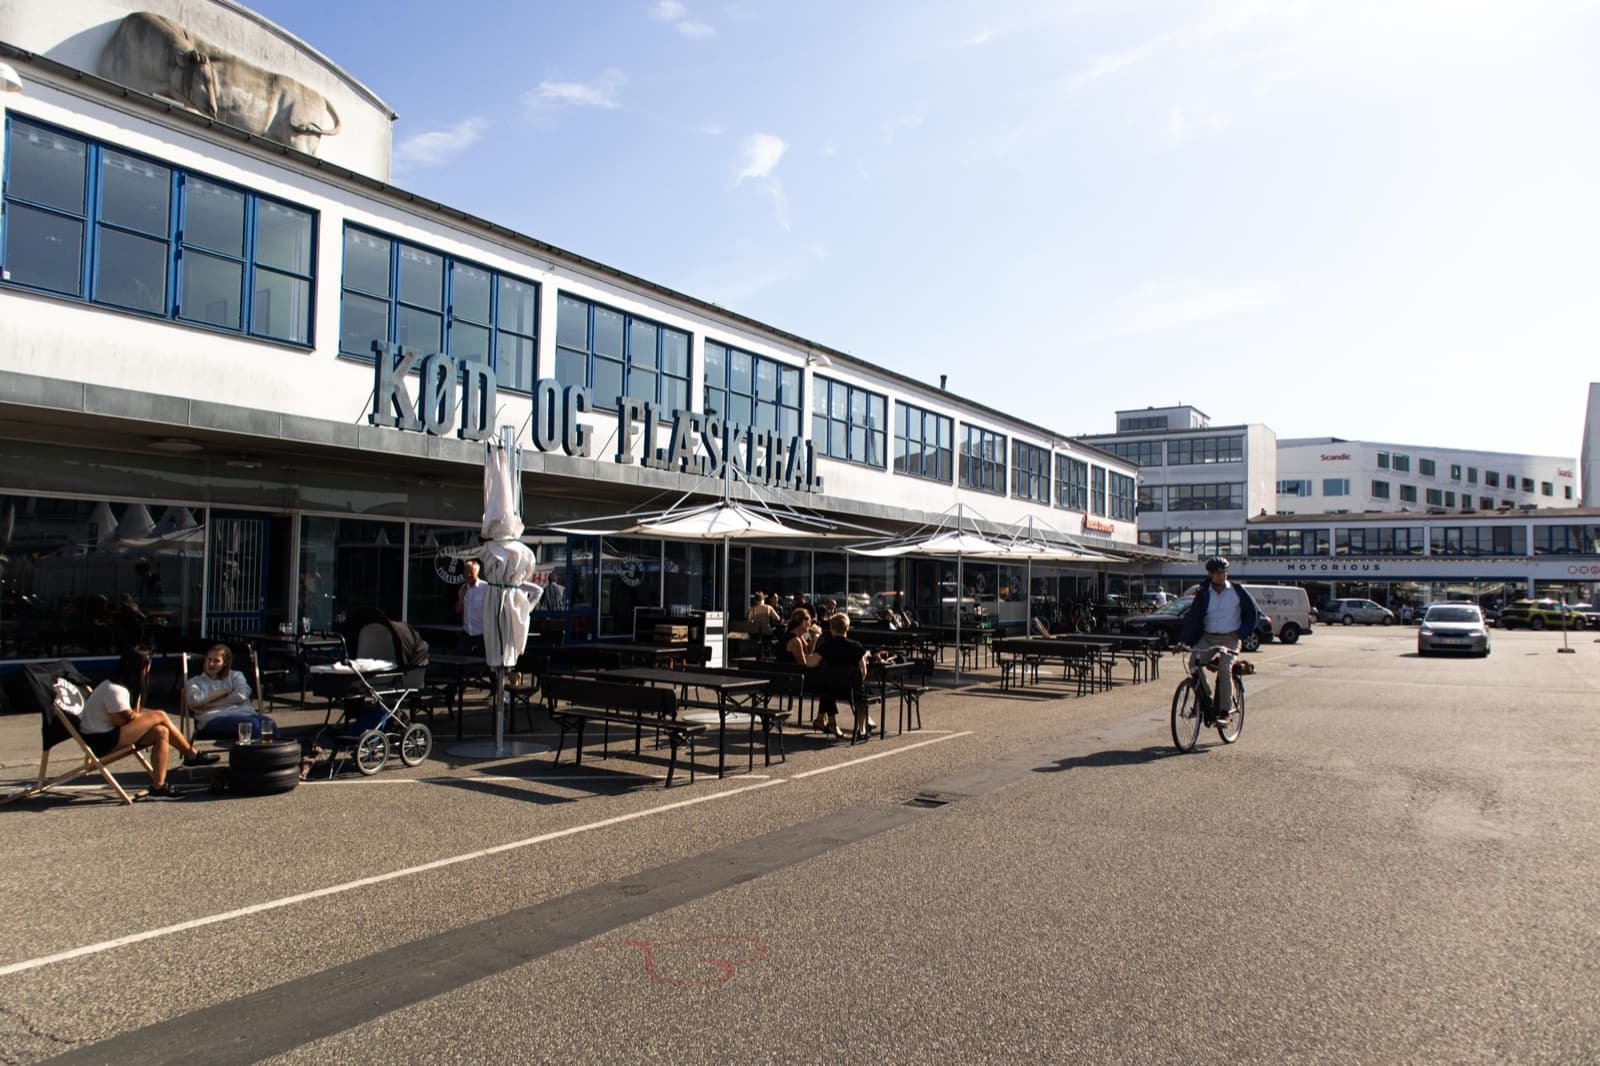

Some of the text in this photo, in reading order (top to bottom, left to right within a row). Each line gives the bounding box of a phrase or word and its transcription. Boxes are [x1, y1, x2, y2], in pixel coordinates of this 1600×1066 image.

[369, 340, 824, 493] KØD OG FLÆSKEHAL
[1320, 453, 1352, 461] Scandic
